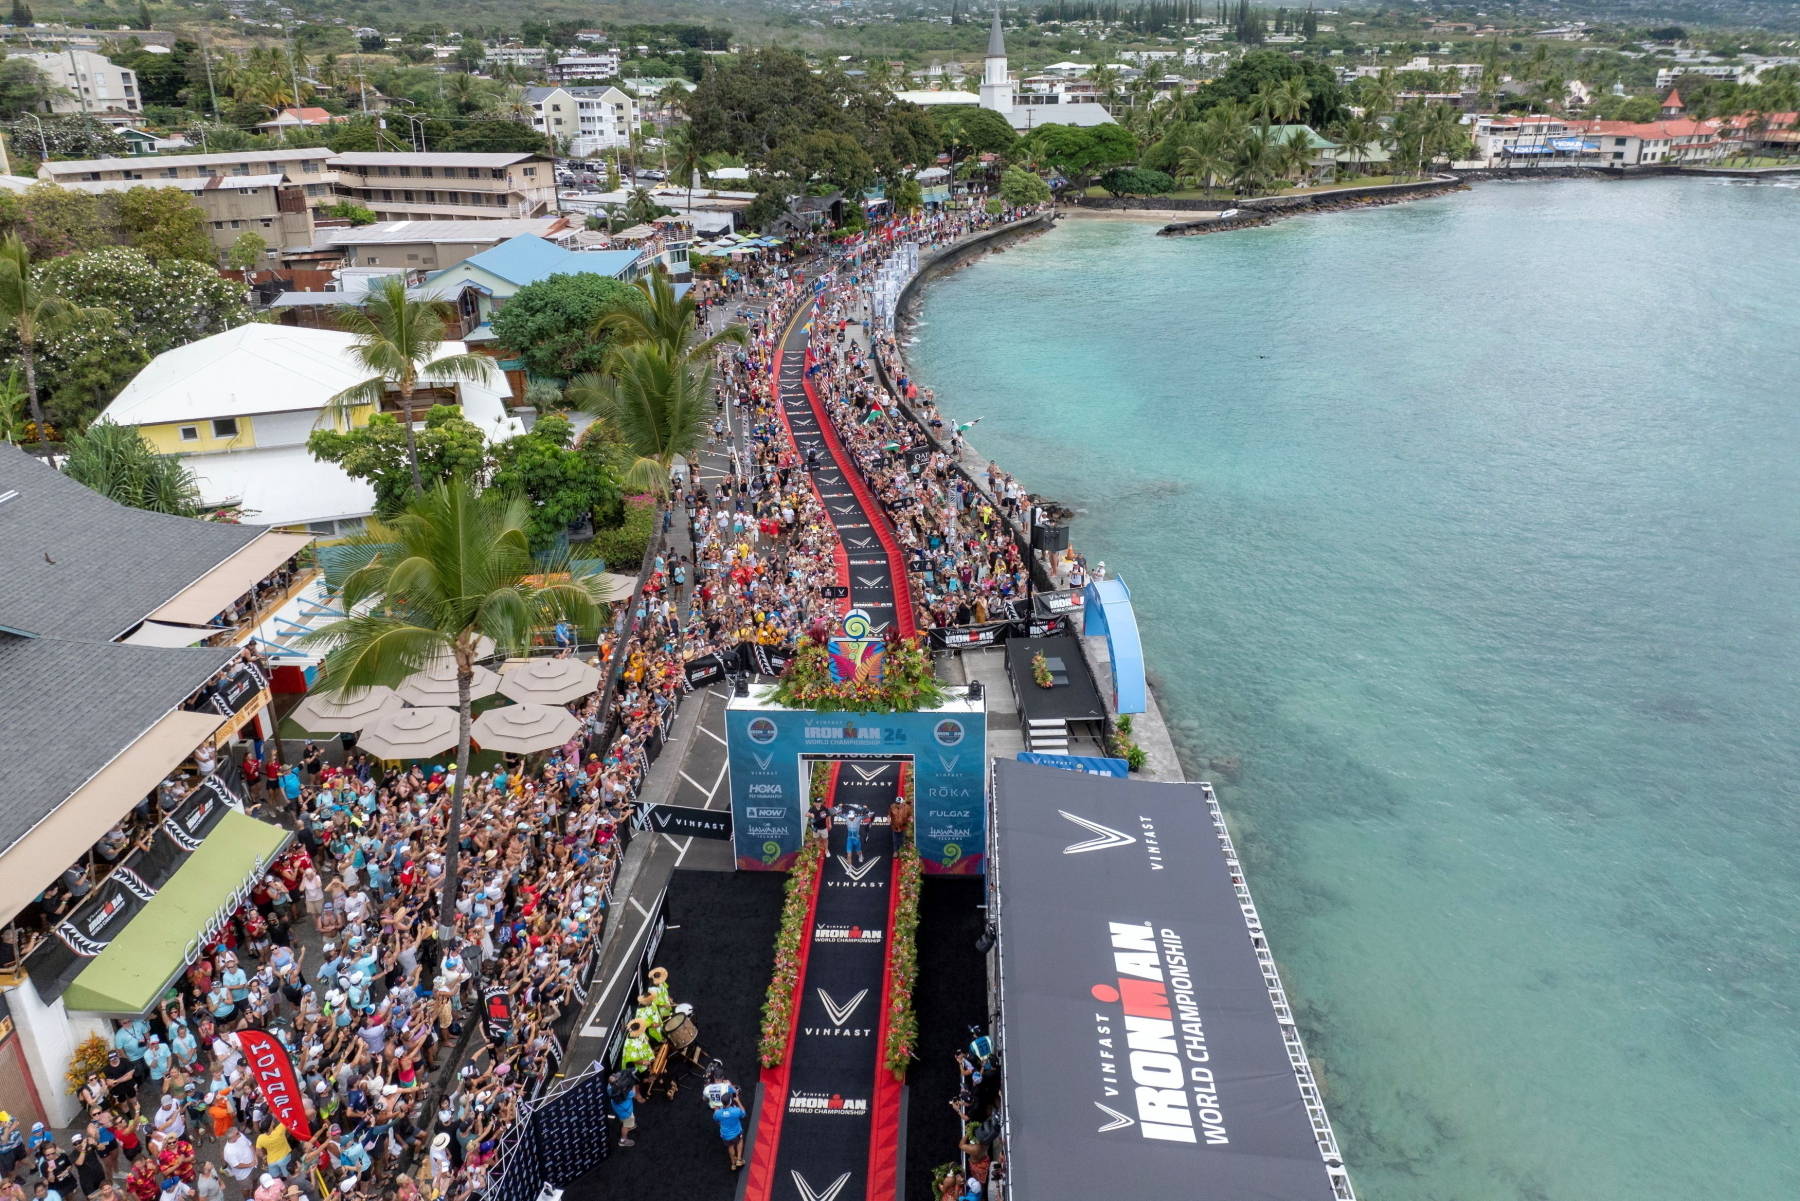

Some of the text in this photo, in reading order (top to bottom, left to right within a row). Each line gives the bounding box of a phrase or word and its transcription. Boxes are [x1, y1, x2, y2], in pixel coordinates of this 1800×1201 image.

[749, 784, 782, 794] HOKA
[675, 818, 725, 830] VINFAST
[1139, 815, 1164, 870] VINFAST
[184, 869, 258, 966] CARILOHA
[815, 927, 882, 938] IRONMAN
[805, 1028, 871, 1037] VINFAST
[1160, 928, 1229, 1144] WORLD CHAMPIONSHIP
[1096, 1013, 1119, 1096] VINFAST
[789, 1095, 868, 1110] IRONMAN
